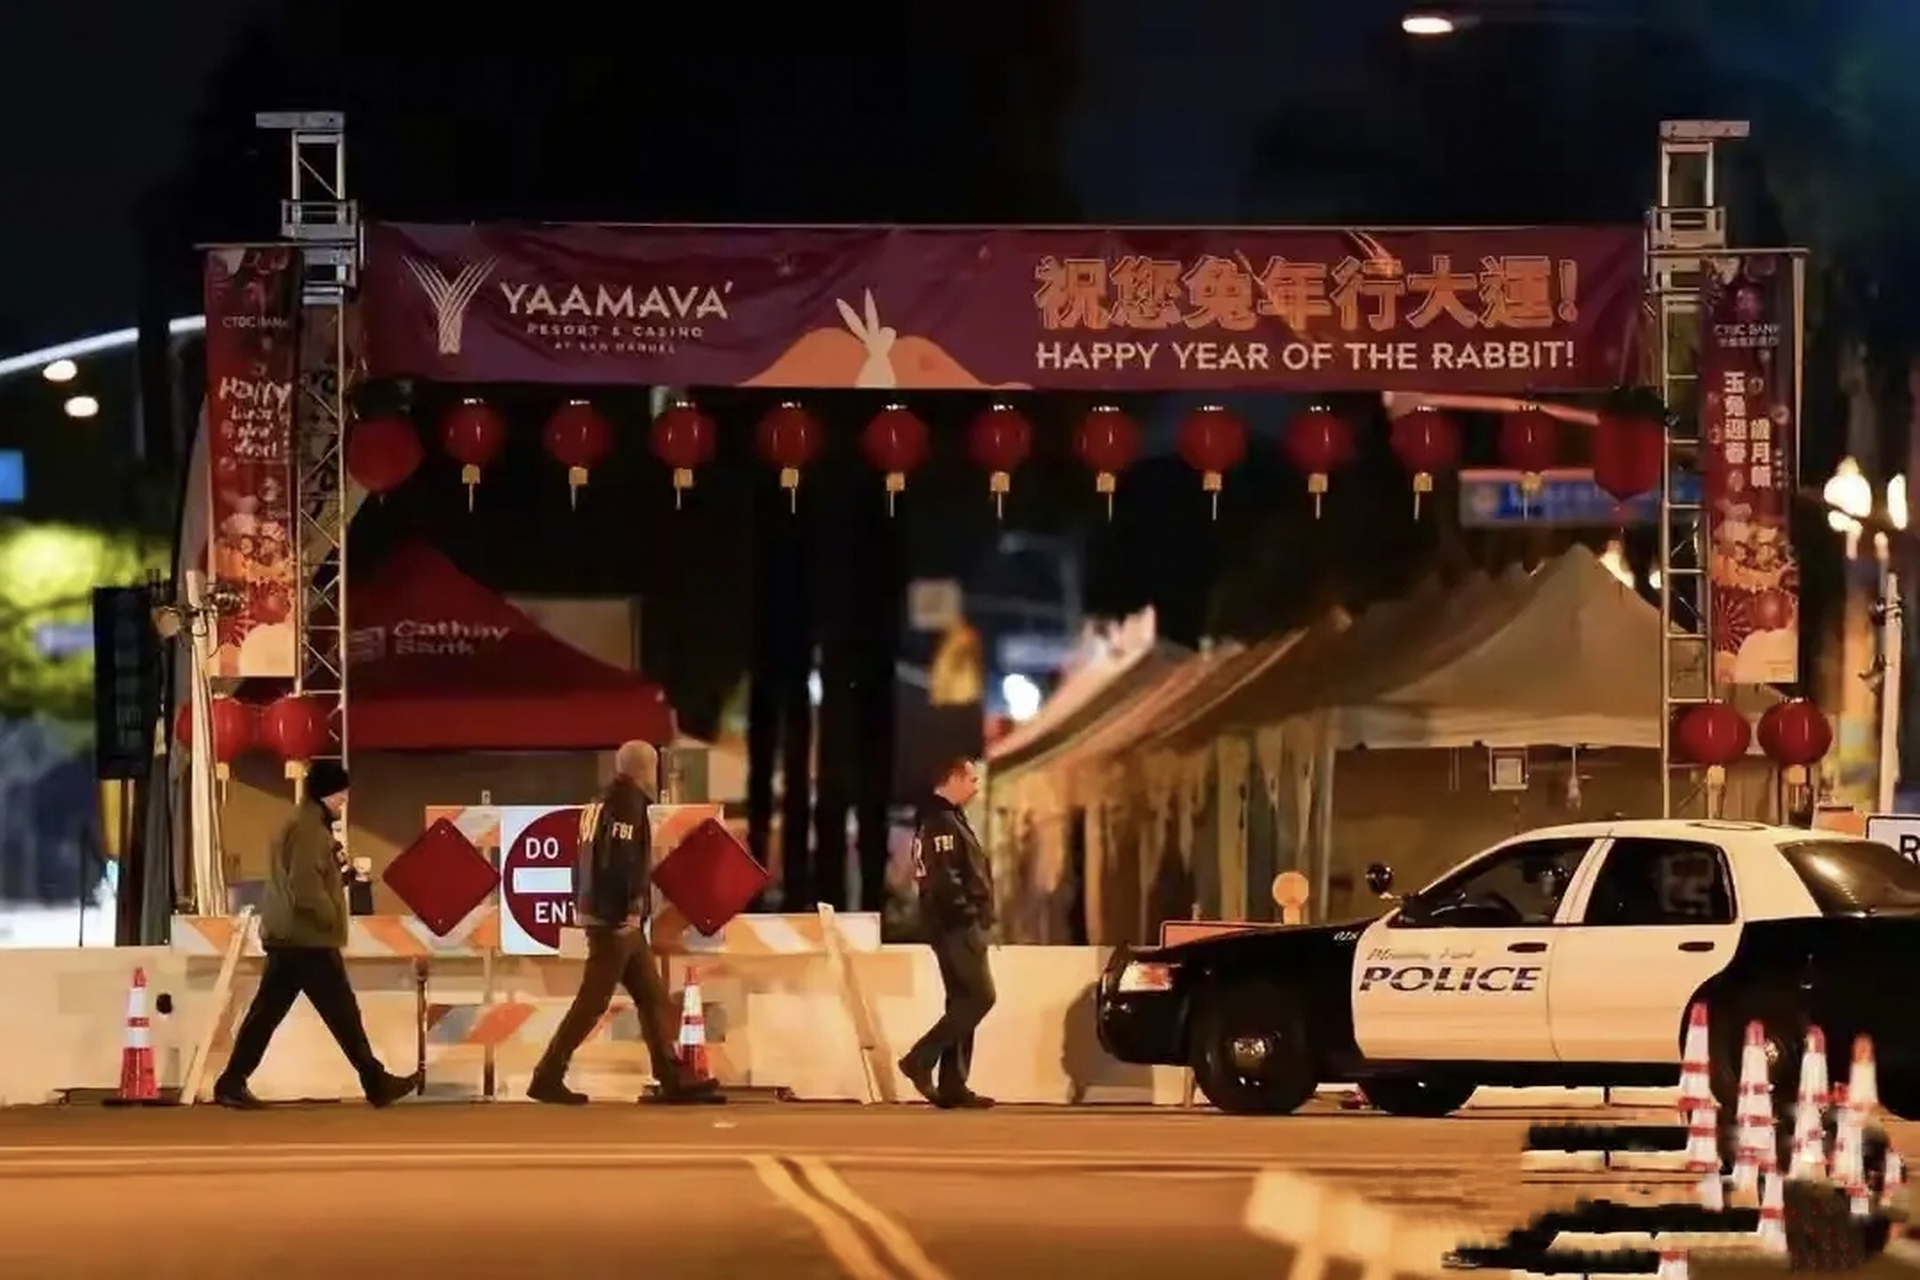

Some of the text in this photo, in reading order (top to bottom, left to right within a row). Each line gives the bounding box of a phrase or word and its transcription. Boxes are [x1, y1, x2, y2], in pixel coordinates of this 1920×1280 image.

[527, 323, 600, 337] RESORT
[632, 325, 705, 339] CASINO
[1036, 340, 1575, 370] HAPPY YEAR OF THE RABBIT!
[394, 619, 511, 642] Cathay
[611, 821, 634, 840] FBI
[525, 837, 559, 860] DO
[933, 834, 954, 852] FBI
[1359, 966, 1543, 992] POLICE
